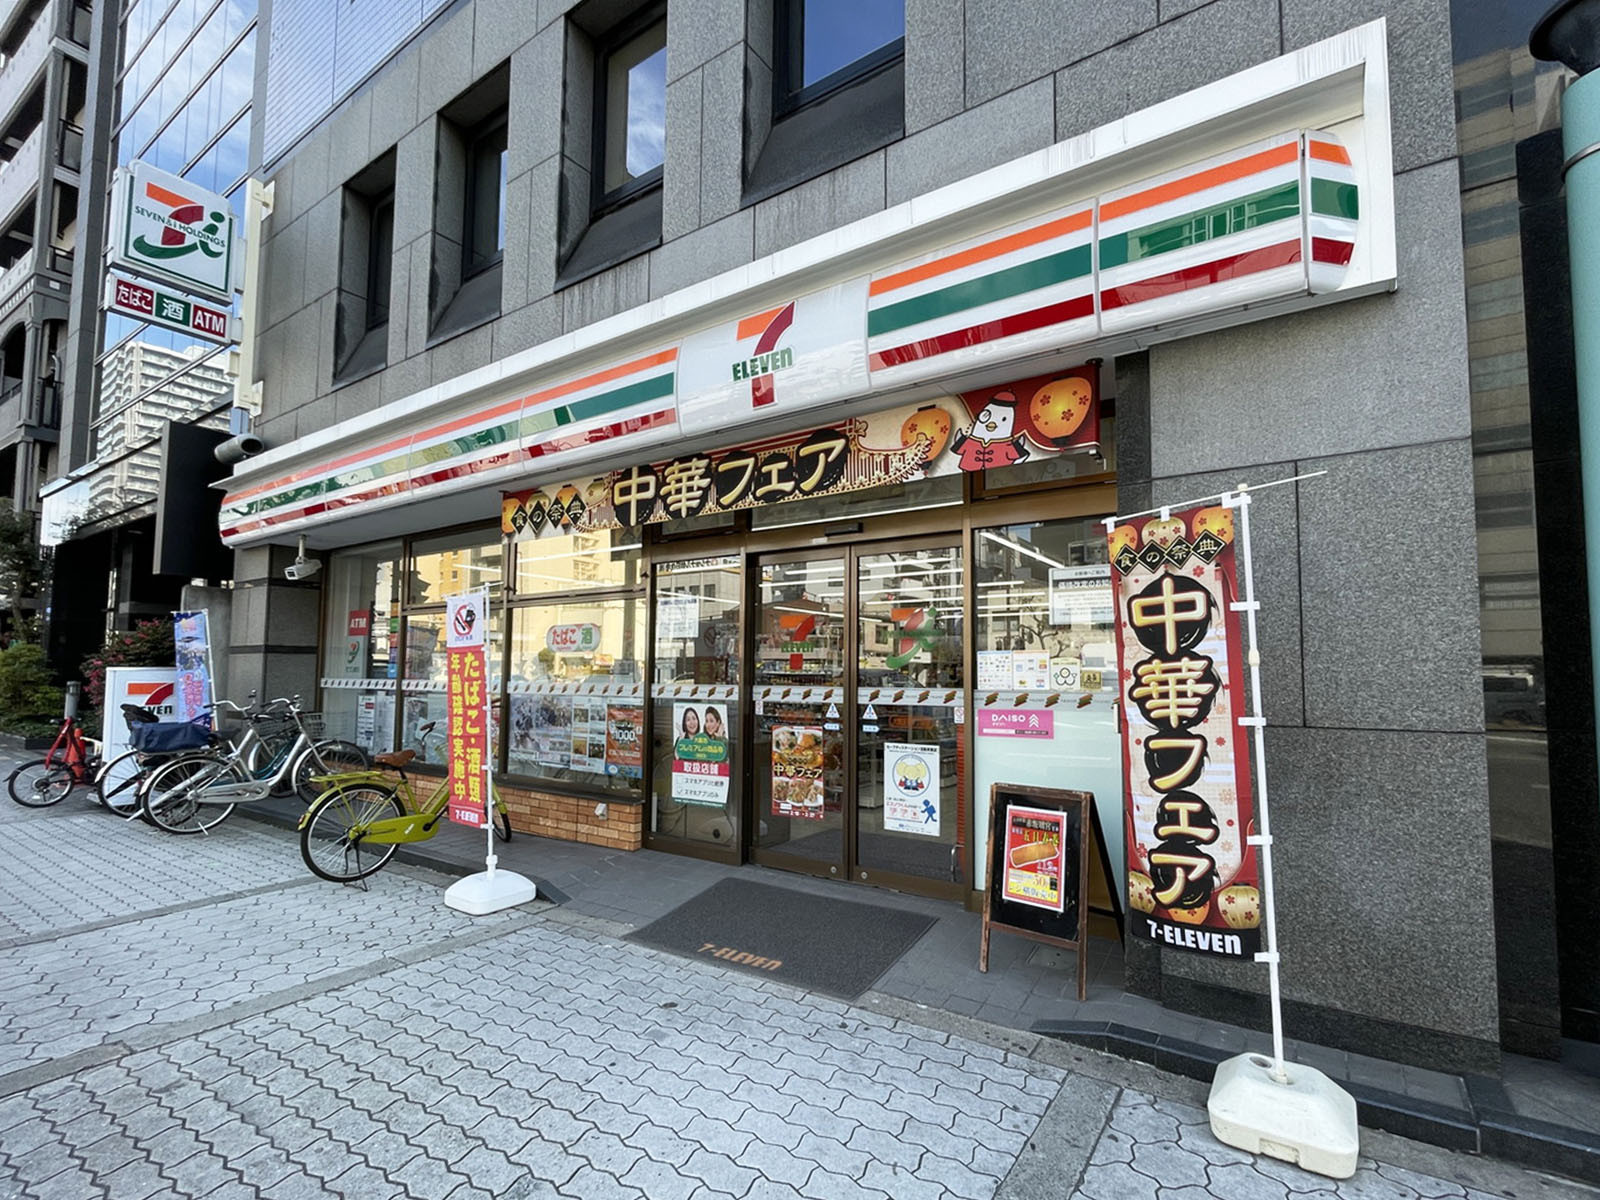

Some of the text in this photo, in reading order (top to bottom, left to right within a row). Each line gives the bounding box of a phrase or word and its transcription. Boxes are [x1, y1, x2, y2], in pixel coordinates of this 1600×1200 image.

[179, 224, 226, 247] HOLDINGS
[117, 284, 152, 311] たばこ
[162, 298, 185, 320] 酒
[194, 310, 225, 334] ATM
[736, 300, 795, 408] 7
[613, 439, 847, 527] 中華フェア
[513, 499, 584, 528] 食の祭典
[1118, 538, 1218, 568] 食の祭典
[350, 618, 367, 628] ATM
[551, 628, 577, 645] たばこ
[581, 627, 593, 645] 酒
[991, 713, 1026, 723] DAISO
[1131, 577, 1216, 905] 中華フェア
[773, 763, 823, 779] 中華フェア
